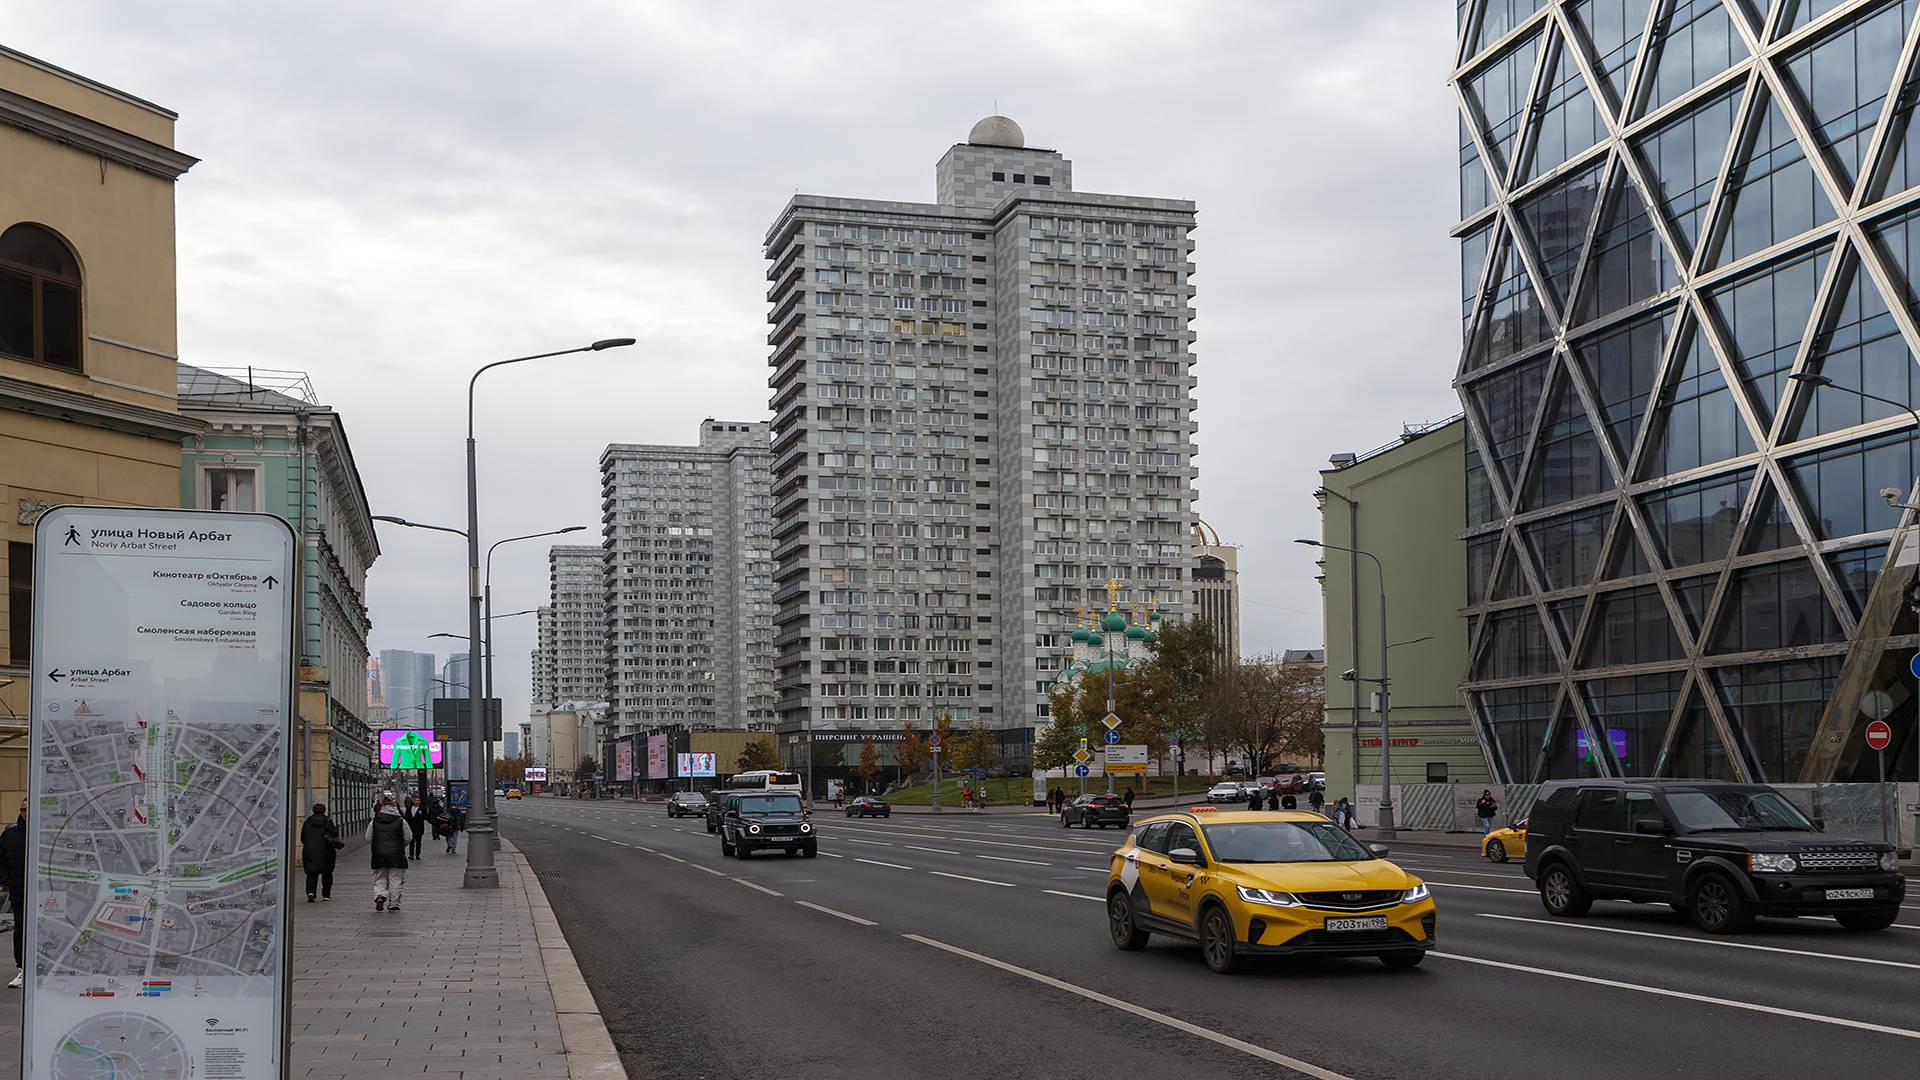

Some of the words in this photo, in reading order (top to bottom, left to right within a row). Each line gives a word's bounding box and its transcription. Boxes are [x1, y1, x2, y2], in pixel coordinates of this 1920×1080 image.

[90, 528, 133, 539] улица
[137, 528, 185, 540] Новый
[188, 530, 232, 542] Арбат
[91, 540, 118, 549] Noviy
[120, 541, 146, 550] Arbat
[149, 542, 177, 550] Street
[152, 570, 204, 580] Кинотеатр
[206, 572, 258, 582] «Октябрь»
[180, 599, 221, 608] Садовое
[223, 601, 257, 609] кольцо
[136, 626, 195, 635] Смоленская
[197, 628, 256, 637] набережная
[70, 669, 99, 677] улица
[101, 668, 131, 677] Арбат
